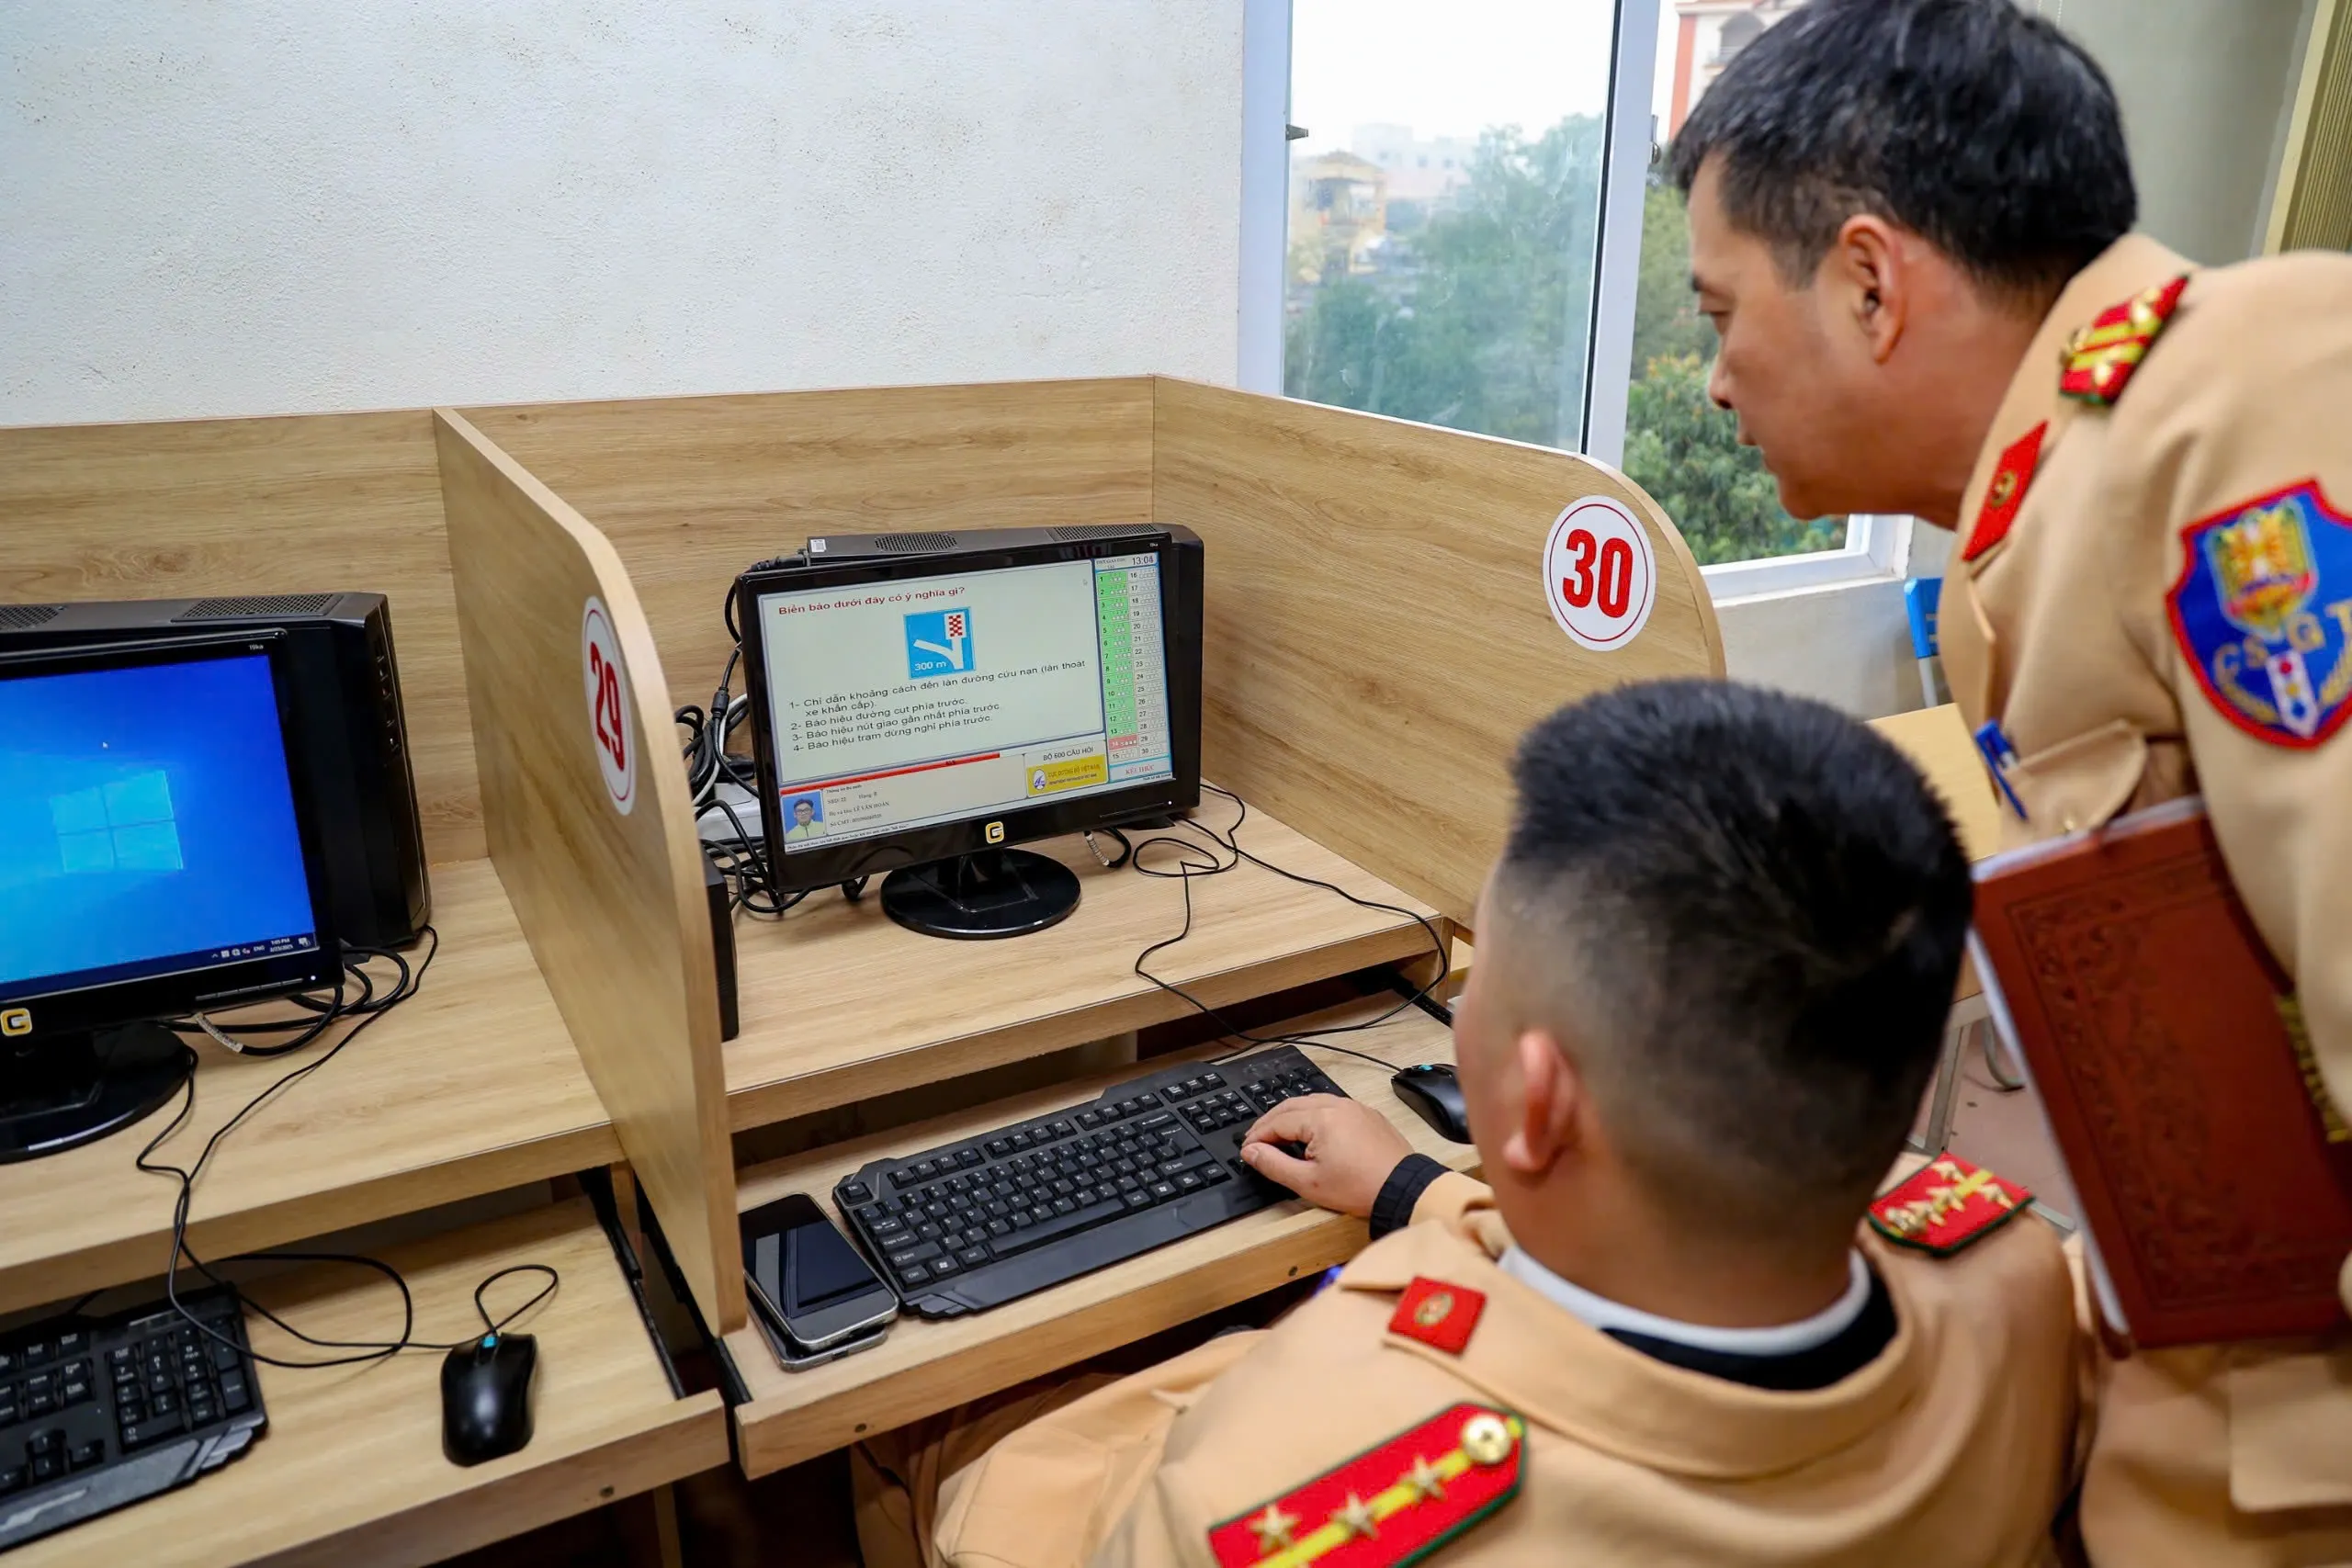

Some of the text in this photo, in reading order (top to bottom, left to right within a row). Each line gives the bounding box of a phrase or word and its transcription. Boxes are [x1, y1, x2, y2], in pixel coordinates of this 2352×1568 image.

[1563, 528, 1633, 618] 30
[778, 604, 806, 615] Biển
[808, 602, 831, 613] báo
[834, 598, 862, 608] dưới
[865, 596, 886, 606] đây
[888, 593, 902, 603] có
[905, 592, 912, 603] ý
[914, 589, 945, 600] nghĩa
[914, 660, 946, 671] 300 m
[789, 702, 800, 710] 1-
[803, 697, 822, 707] Chỉ
[825, 694, 846, 704] dẫn
[849, 688, 888, 701] khoảng
[892, 683, 917, 694] cách
[920, 681, 939, 690] đến
[943, 678, 958, 687] làn
[961, 672, 995, 685] đường
[998, 671, 1017, 679] cứu
[590, 641, 625, 772] 29
[805, 709, 819, 717] xe
[821, 705, 847, 715] khẩn
[790, 723, 802, 731] 2-
[805, 718, 827, 729] Báo
[830, 715, 853, 726] hiệu
[855, 709, 890, 721] đường
[807, 730, 828, 739] Báo
[831, 727, 854, 738] hiệu
[856, 723, 874, 732] nút
[876, 719, 899, 730] giao
[901, 715, 921, 726] gần
[923, 709, 946, 721] nhất
[793, 744, 804, 752] 4-
[808, 740, 829, 750] Báo
[831, 737, 854, 748] hiệu
[1043, 752, 1053, 761] BỘ
[1054, 750, 1066, 759] 600
[1066, 747, 1080, 757] CÂU
